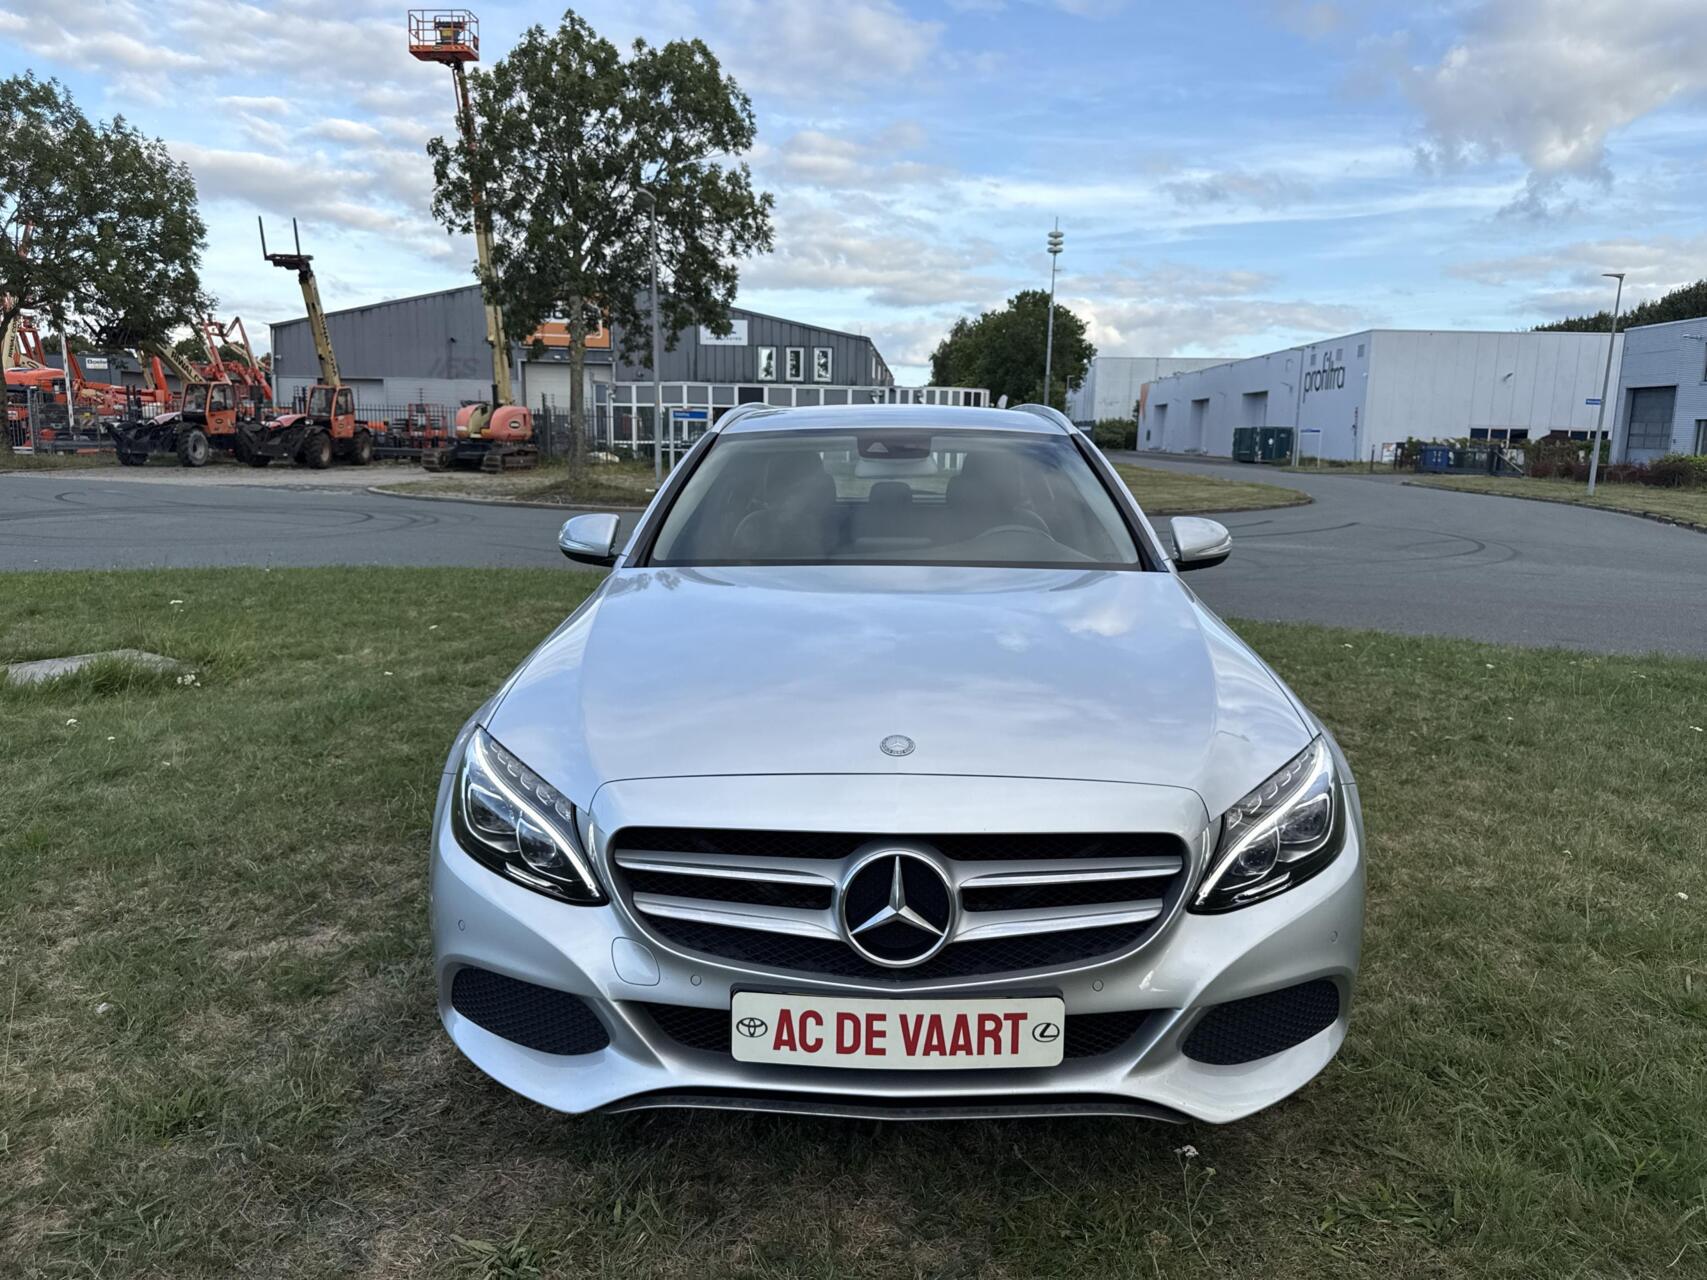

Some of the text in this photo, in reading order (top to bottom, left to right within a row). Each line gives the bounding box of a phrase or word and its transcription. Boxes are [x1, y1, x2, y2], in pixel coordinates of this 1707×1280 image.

[1302, 351, 1346, 404] profiltra
[773, 1008, 1027, 1057] AC DE VAART
